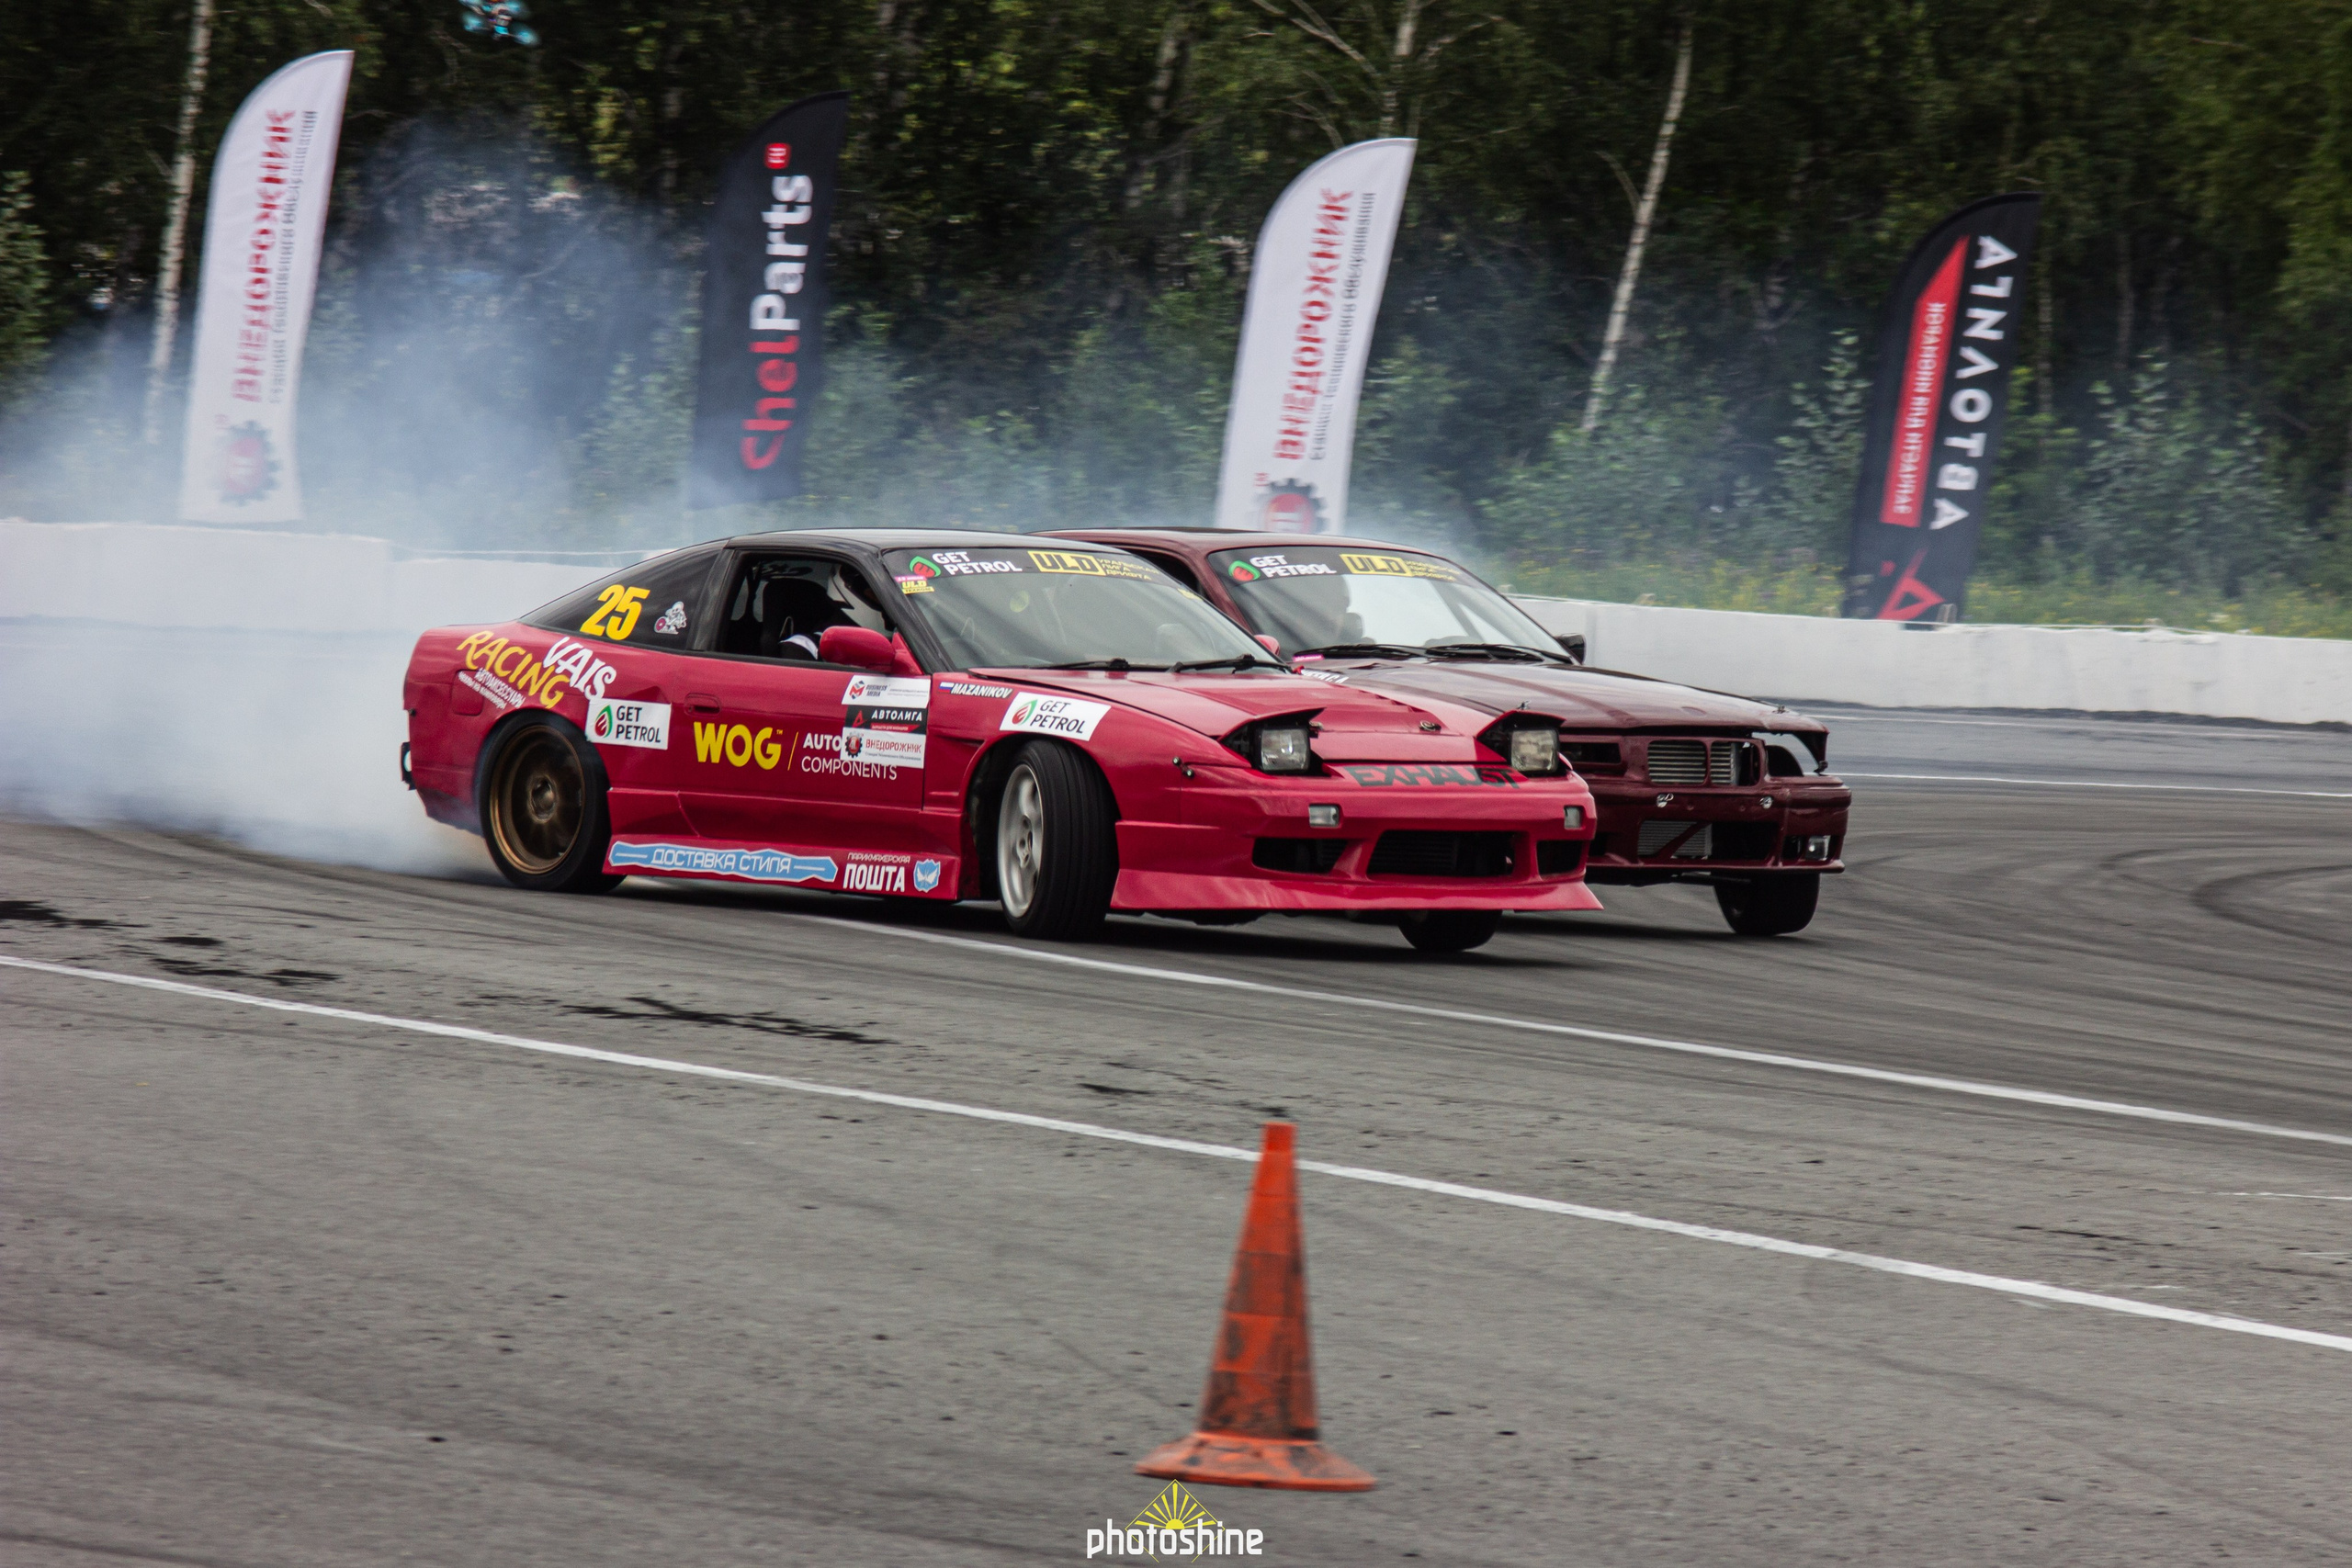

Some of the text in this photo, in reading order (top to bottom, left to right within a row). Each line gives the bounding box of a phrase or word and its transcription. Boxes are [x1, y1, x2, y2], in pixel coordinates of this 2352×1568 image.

[232, 109, 297, 402] ВНЕДОРОЖНИК
[1272, 188, 1353, 459] ВНЕДОРОЖНИК
[932, 551, 970, 564] GET
[1034, 553, 1100, 572] ULD
[1249, 555, 1286, 567] GET
[1346, 557, 1404, 573] ULD
[943, 560, 1023, 576] PETROL
[1261, 563, 1337, 578] PETROL
[902, 581, 926, 589] ULD
[580, 584, 650, 640] 25
[457, 630, 570, 709] RACING
[543, 637, 616, 701] VAIS
[951, 682, 1012, 699] MAZANIKOV
[616, 705, 642, 722] GET
[871, 709, 922, 722] АВТОЛИГА
[1039, 700, 1070, 714] GET
[616, 725, 662, 743] PETROL
[1030, 715, 1086, 734] PETROL
[694, 721, 782, 770] WOG
[803, 732, 842, 752] AUTO
[865, 739, 922, 753] ВНЕДОРОЖНИК
[801, 756, 897, 781] COMPONENTS
[1343, 765, 1521, 789] EXHAUST
[650, 848, 735, 871] ДОСТАВКА
[739, 852, 792, 874] СТИЛЯ
[847, 852, 911, 864] ПАРИКМАХЕРСКАЯ
[843, 865, 906, 893] ПОШТА
